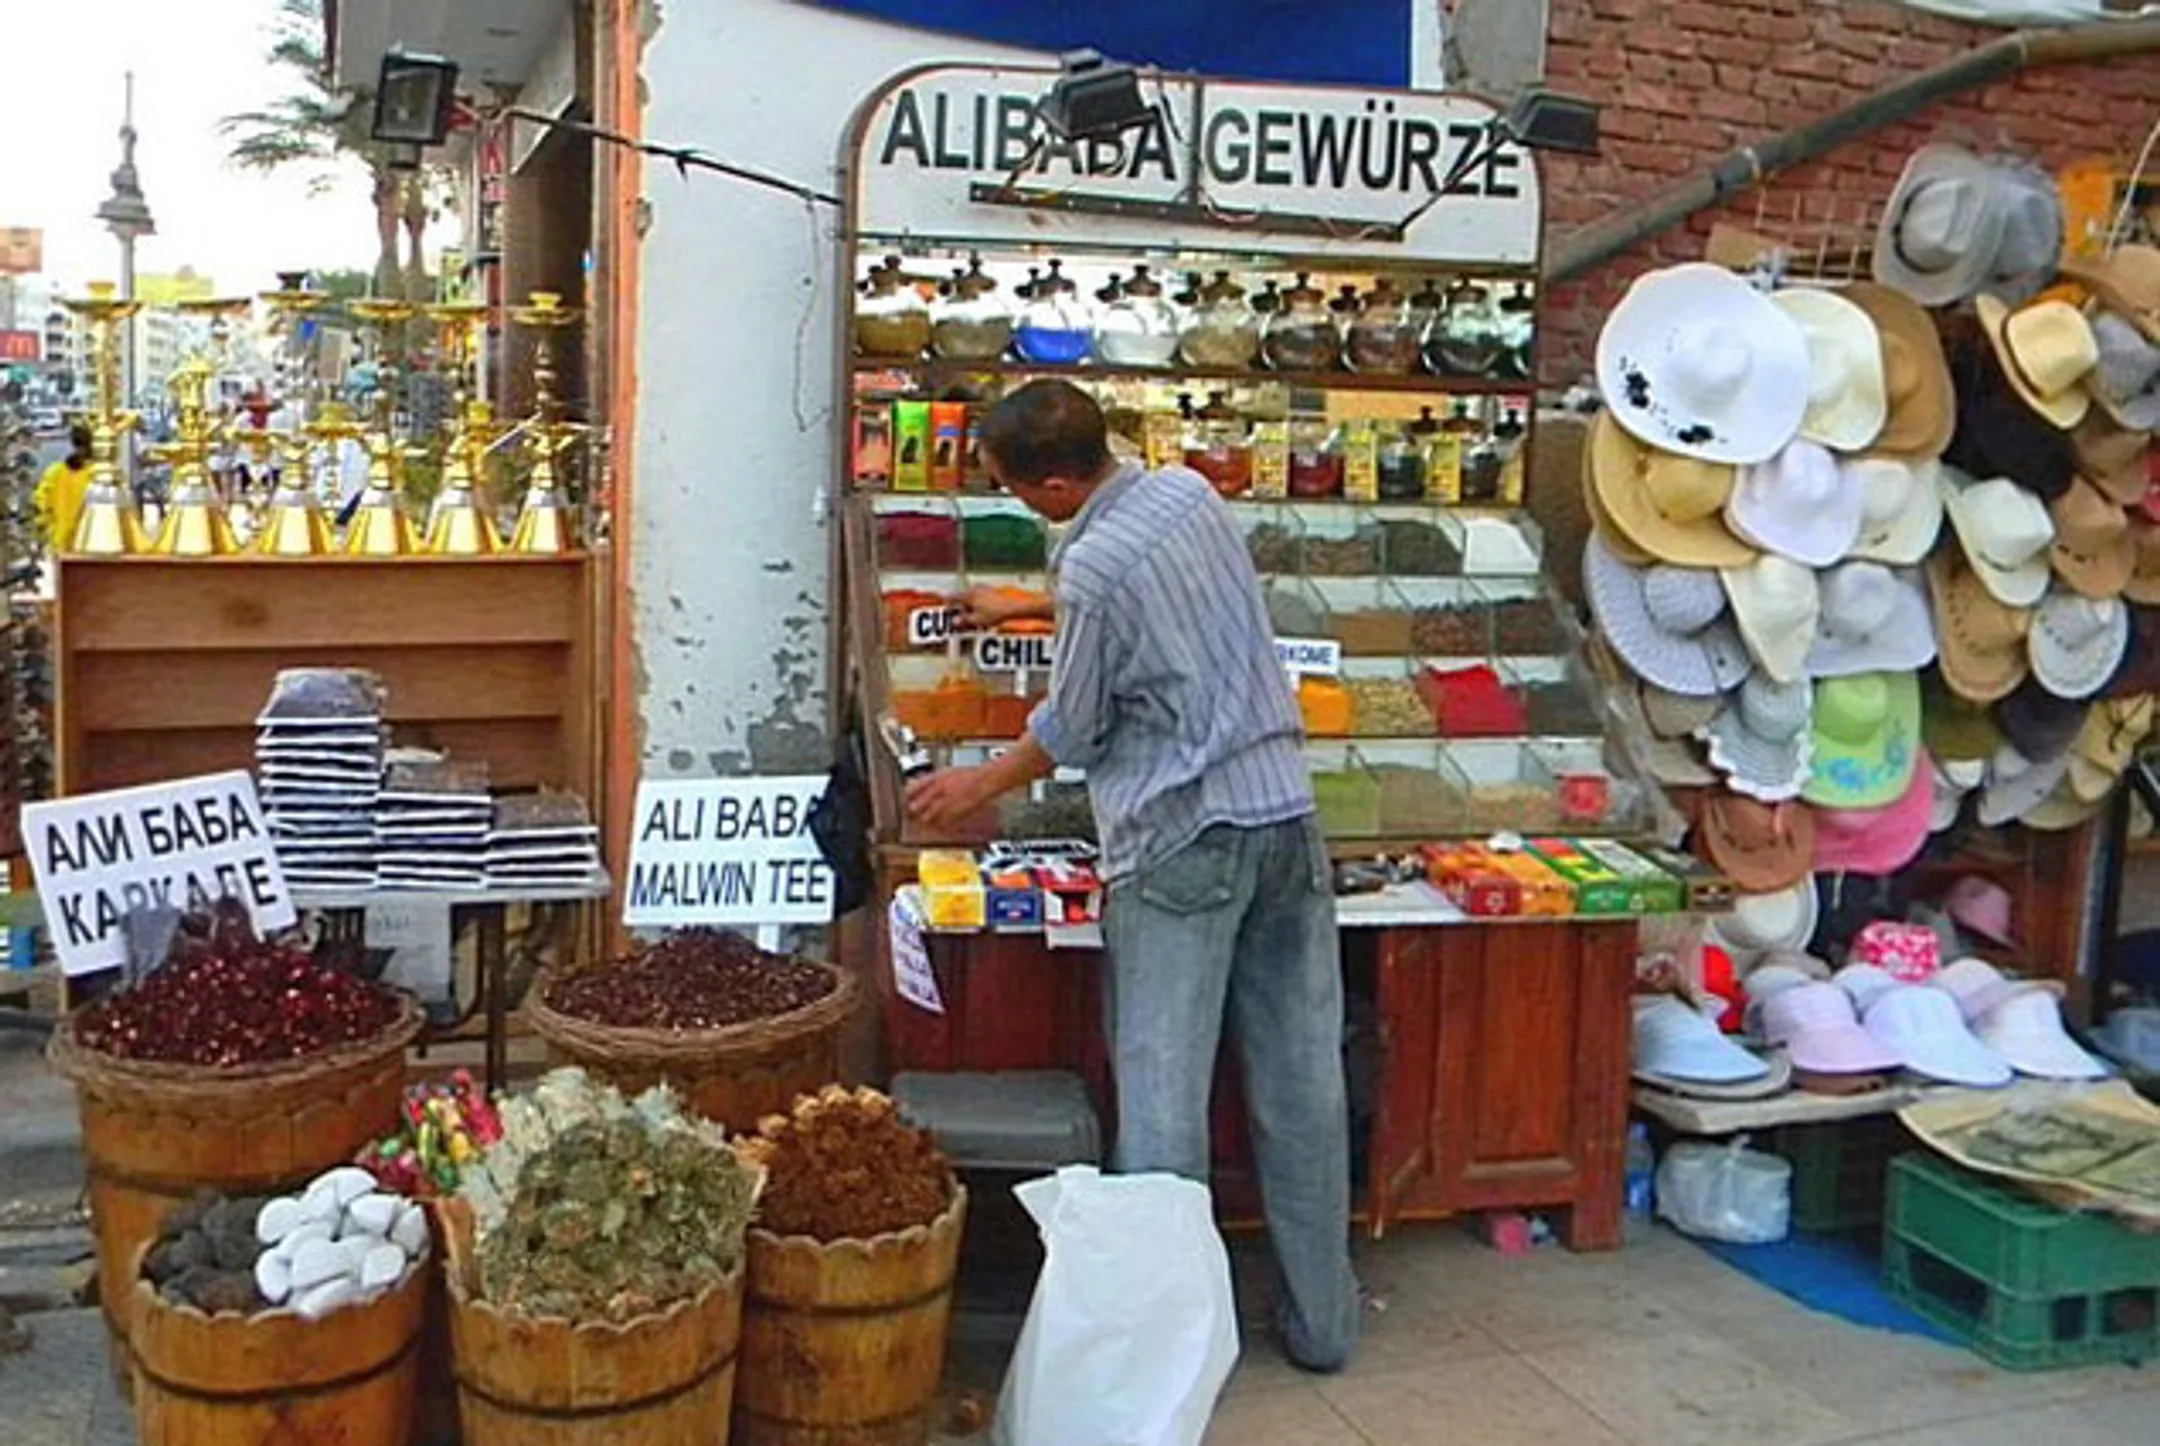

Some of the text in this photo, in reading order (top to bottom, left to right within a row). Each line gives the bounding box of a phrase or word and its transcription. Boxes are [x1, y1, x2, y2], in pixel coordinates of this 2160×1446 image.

[880, 88, 1520, 197] ALIBABA GEWÜRZE
[980, 637, 1053, 666] CHIL
[46, 812, 134, 876] АЛИ
[139, 792, 258, 856] БАБА
[641, 798, 706, 842] ALI
[630, 856, 831, 907] MALWIN TEE
